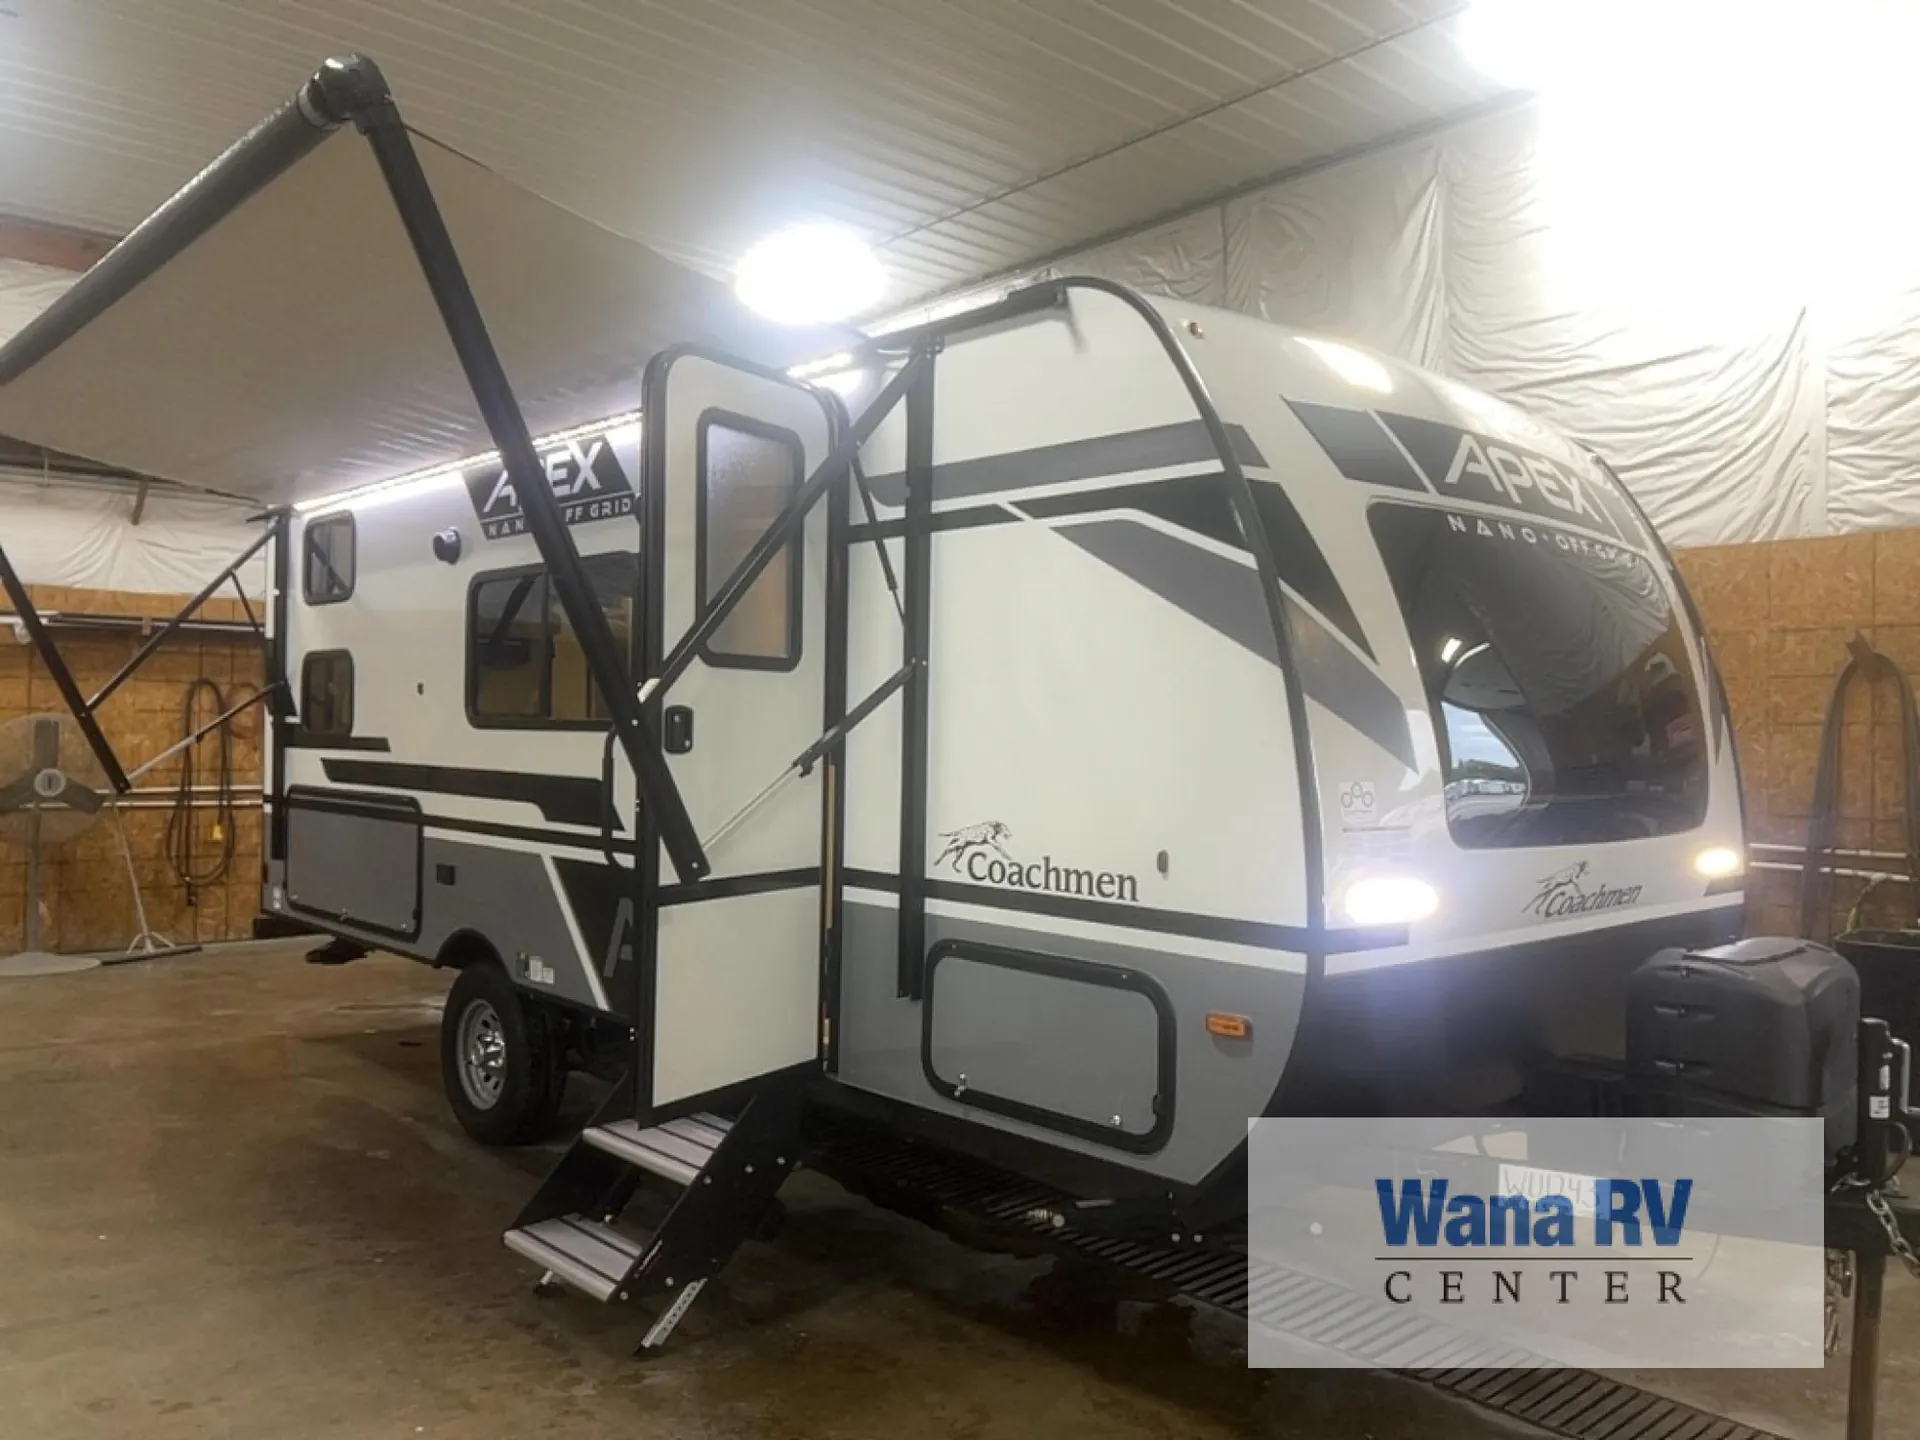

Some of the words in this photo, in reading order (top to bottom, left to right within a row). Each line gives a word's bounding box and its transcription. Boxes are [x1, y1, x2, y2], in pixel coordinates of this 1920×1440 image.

[483, 440, 603, 513] AEX
[1444, 434, 1603, 523] APEX
[488, 518, 524, 538] NAN
[565, 506, 583, 522] FF
[590, 498, 631, 517] GRID
[1446, 514, 1538, 545] NANO
[967, 851, 1139, 902] Coachmen
[1543, 884, 1644, 918] Coachmen
